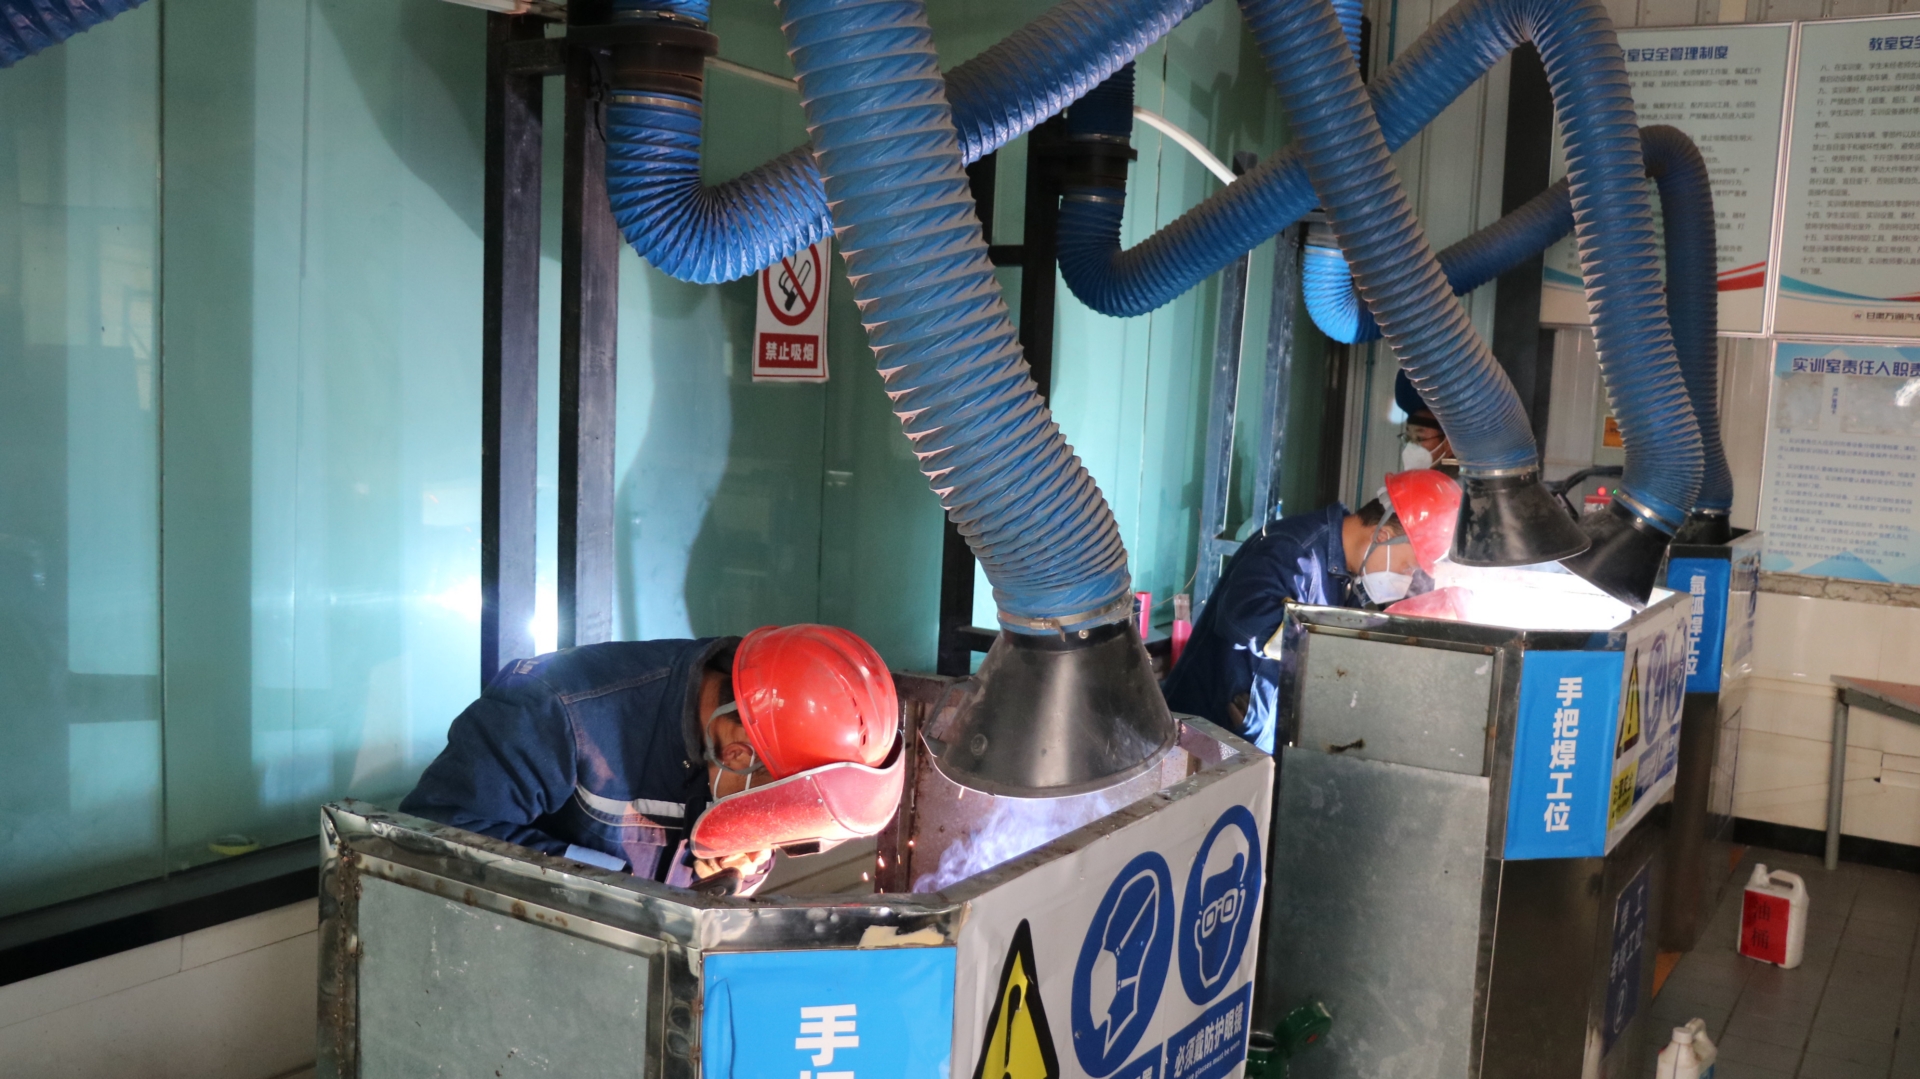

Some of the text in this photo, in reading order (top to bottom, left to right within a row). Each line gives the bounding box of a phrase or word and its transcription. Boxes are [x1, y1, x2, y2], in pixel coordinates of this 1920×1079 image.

[1621, 46, 1728, 63] 室安全管理制度
[765, 341, 814, 361] 禁止吸烟
[1793, 358, 1920, 377] 实训室责任人职责
[1543, 676, 1583, 833] 手把焊工位
[795, 1003, 860, 1079] 手
[1174, 1002, 1244, 1078] 必须戴防护眼镜
